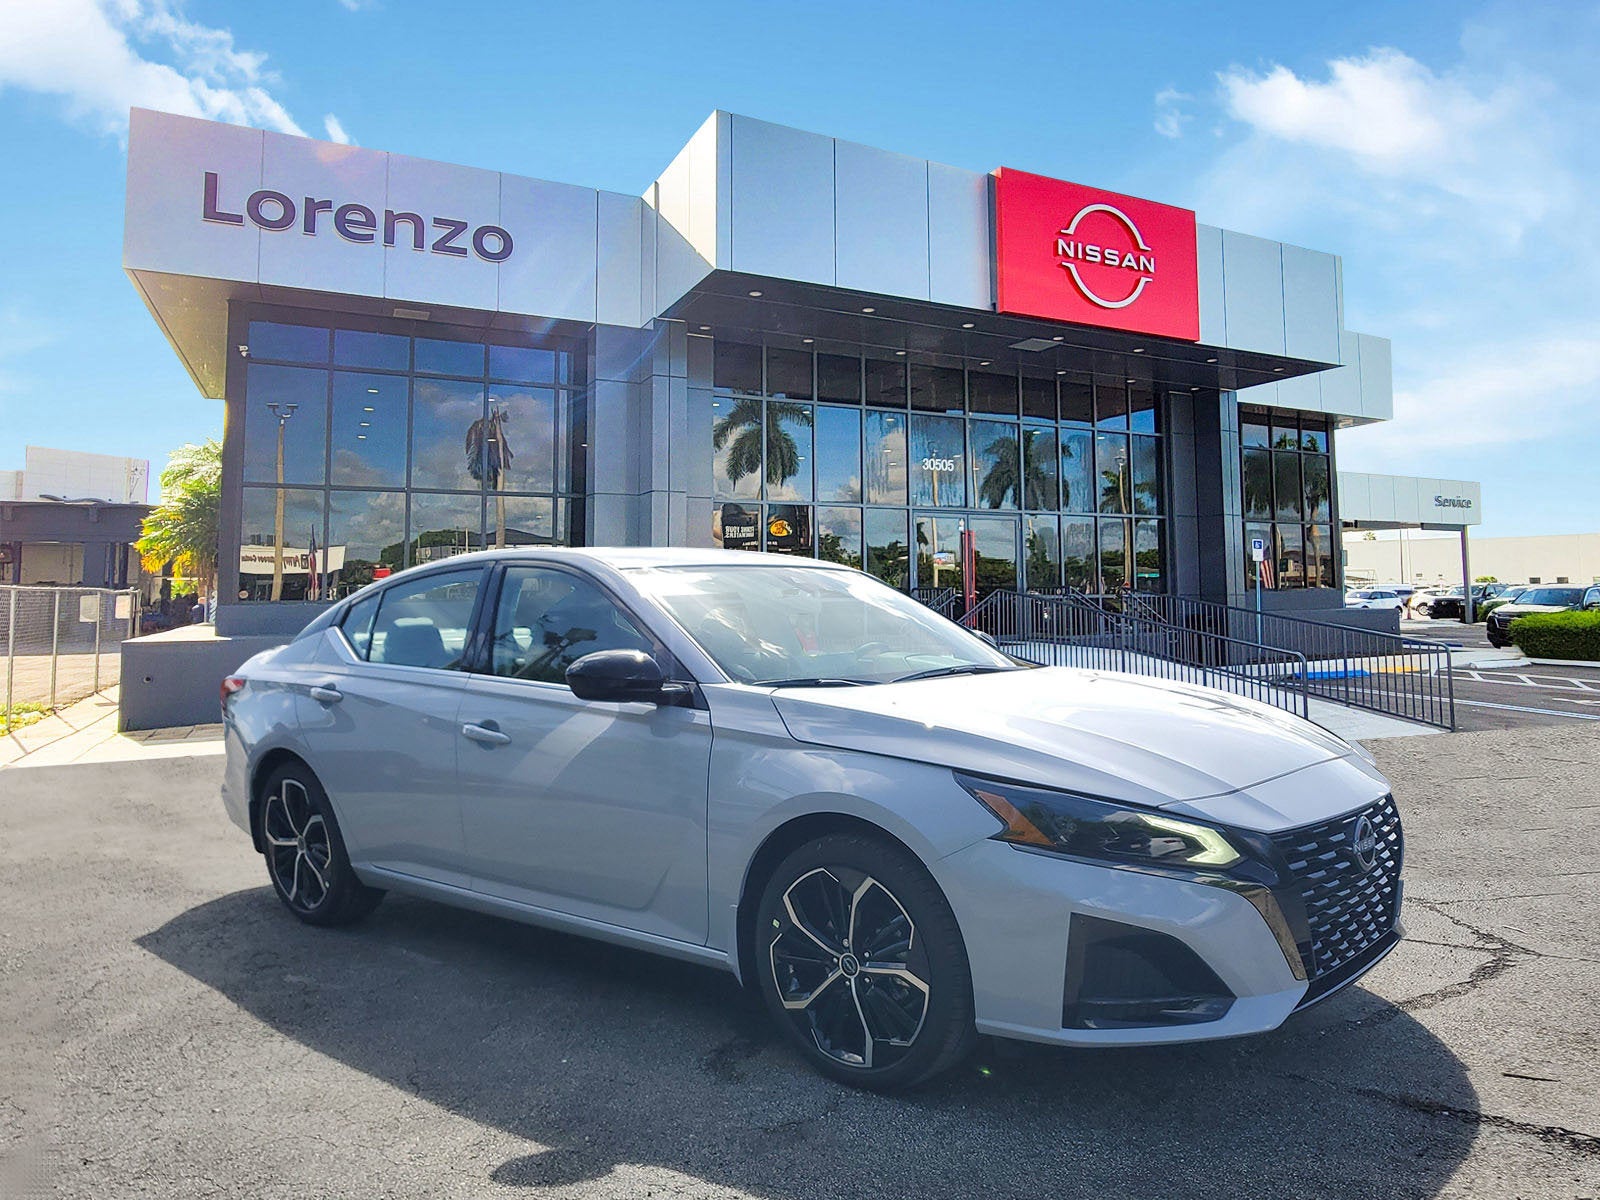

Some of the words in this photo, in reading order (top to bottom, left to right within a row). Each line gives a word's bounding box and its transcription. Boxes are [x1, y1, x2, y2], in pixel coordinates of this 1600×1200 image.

[201, 170, 514, 263] Lorenzo
[1057, 238, 1155, 273] NISSAN
[922, 457, 955, 472] 30505
[1434, 495, 1472, 509] Service
